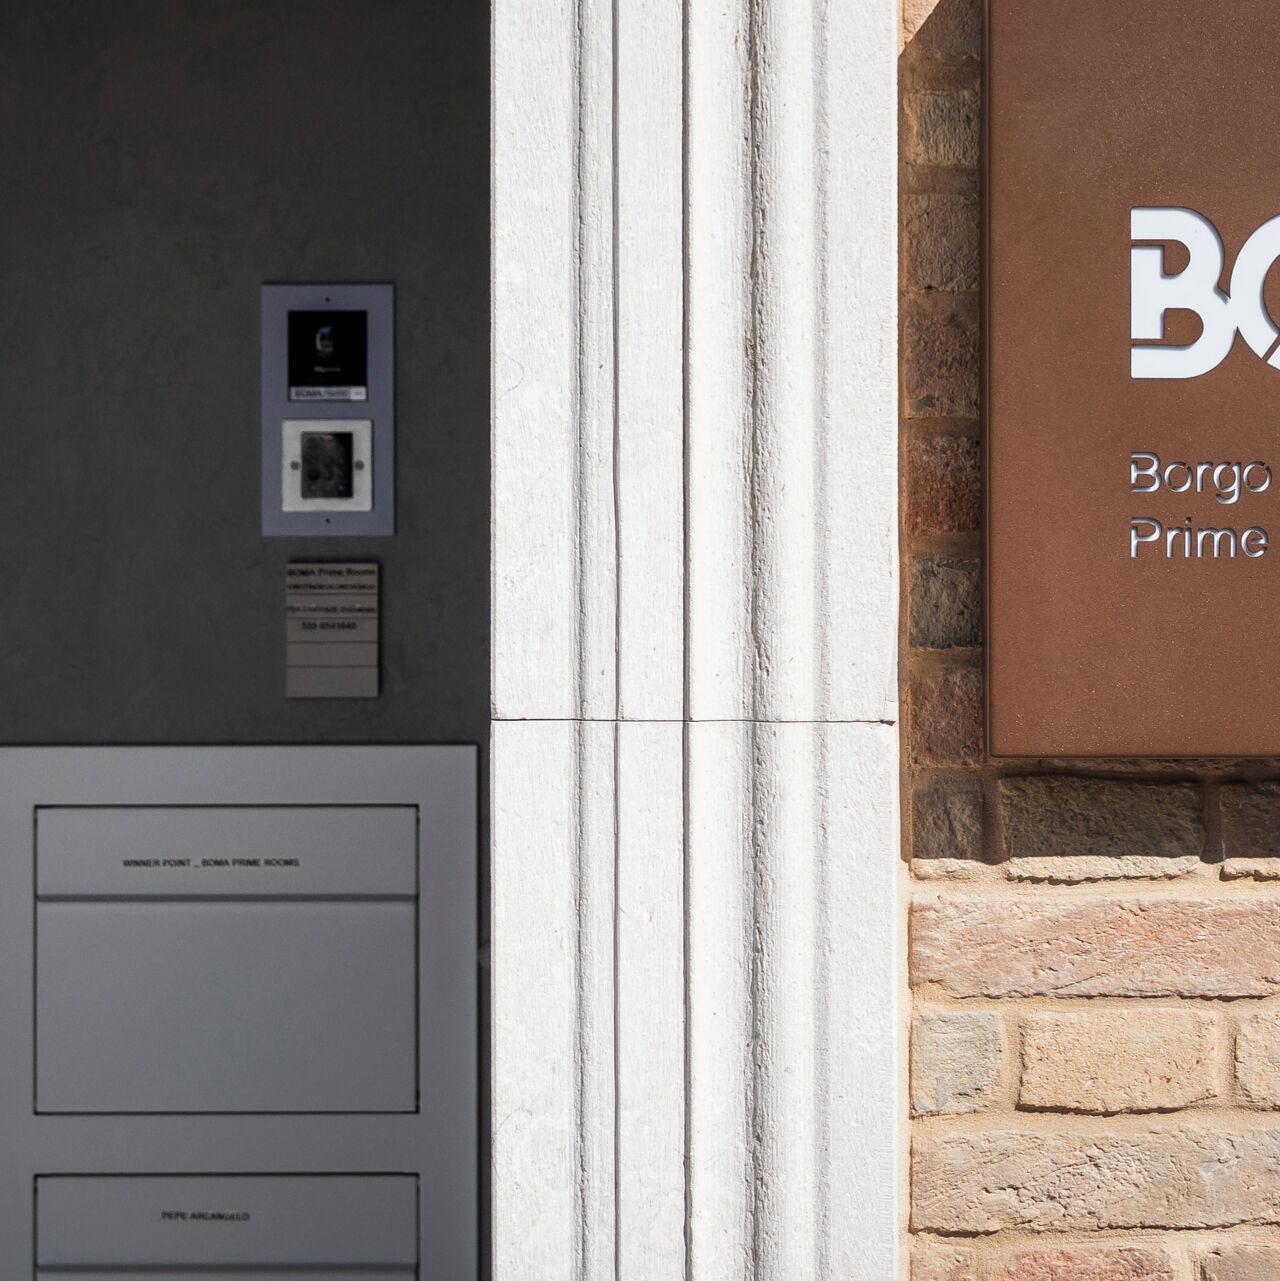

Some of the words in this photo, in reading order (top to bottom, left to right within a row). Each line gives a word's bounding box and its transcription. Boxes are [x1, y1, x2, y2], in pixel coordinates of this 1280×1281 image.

[1130, 451, 1273, 505] Borgo
[1130, 517, 1269, 559] Prime
[122, 858, 160, 867] WINNER
[162, 858, 191, 867] POINT
[201, 858, 230, 867] BOMA
[231, 858, 261, 867] PRIME
[263, 858, 301, 867] ROOMS
